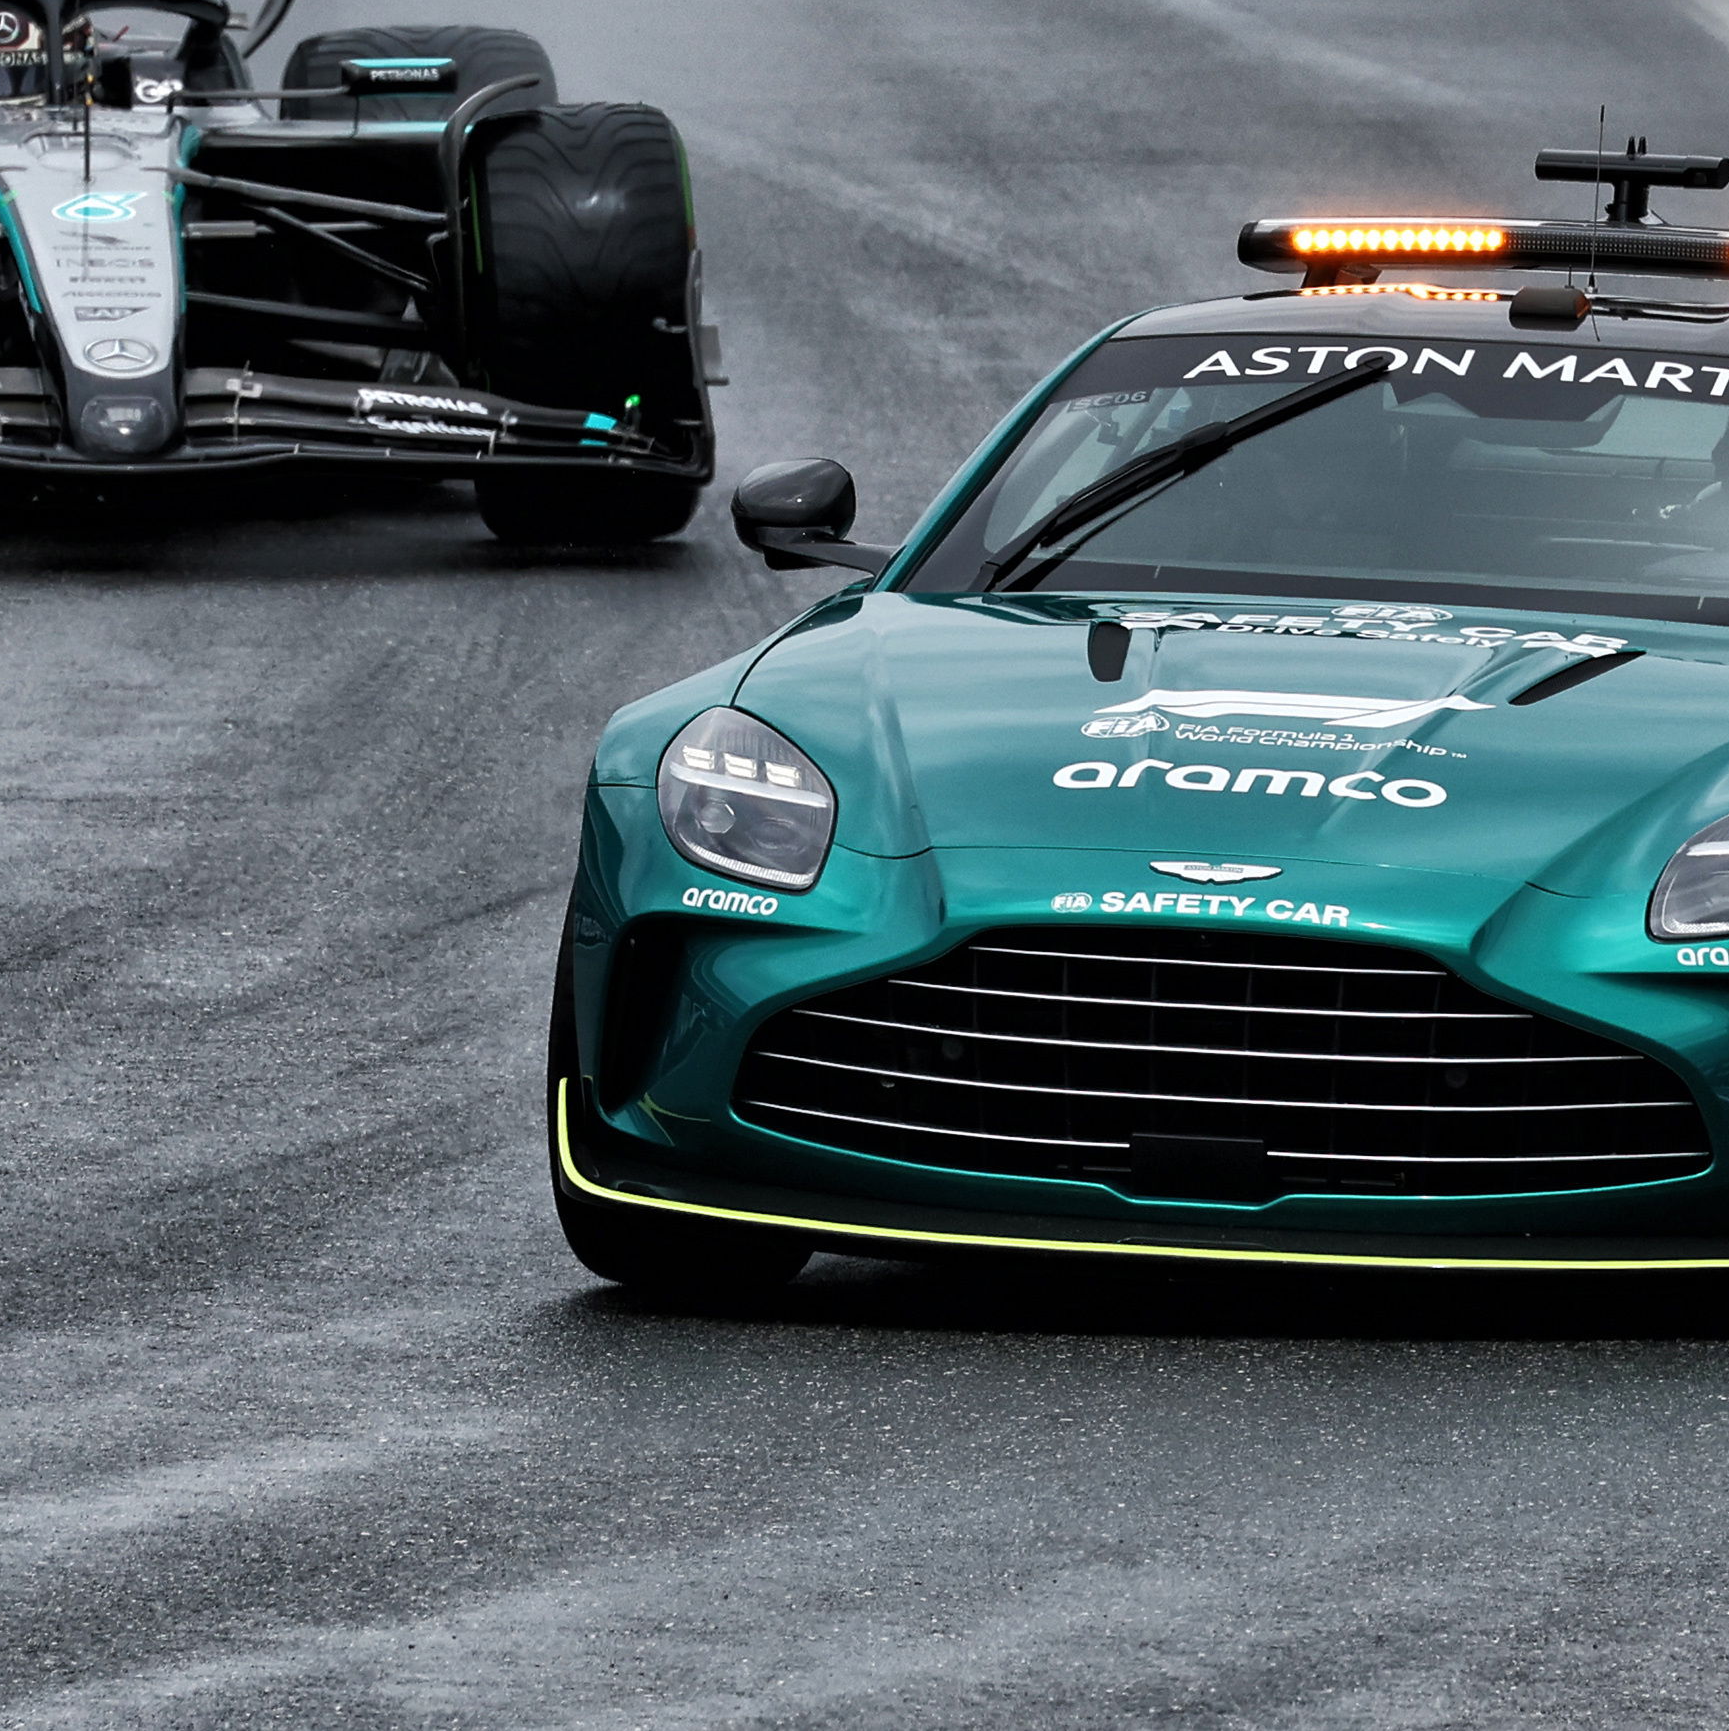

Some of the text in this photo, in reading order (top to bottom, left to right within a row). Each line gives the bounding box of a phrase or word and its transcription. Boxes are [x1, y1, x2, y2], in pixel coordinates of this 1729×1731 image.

[370, 68, 440, 82] PETRONAS
[1183, 345, 1475, 380] ASTON
[358, 388, 488, 415] PETRONAS
[1072, 391, 1147, 410] SC06
[1120, 612, 1629, 649] SAFETY CAR
[1216, 624, 1342, 636] Drive
[1175, 729, 1254, 744] World
[1176, 723, 1355, 742] FIA Formula 1
[1052, 758, 1448, 808] aramco
[682, 887, 779, 916] aramco
[1100, 891, 1256, 917] SAFETY
[1265, 899, 1350, 927] CAR
